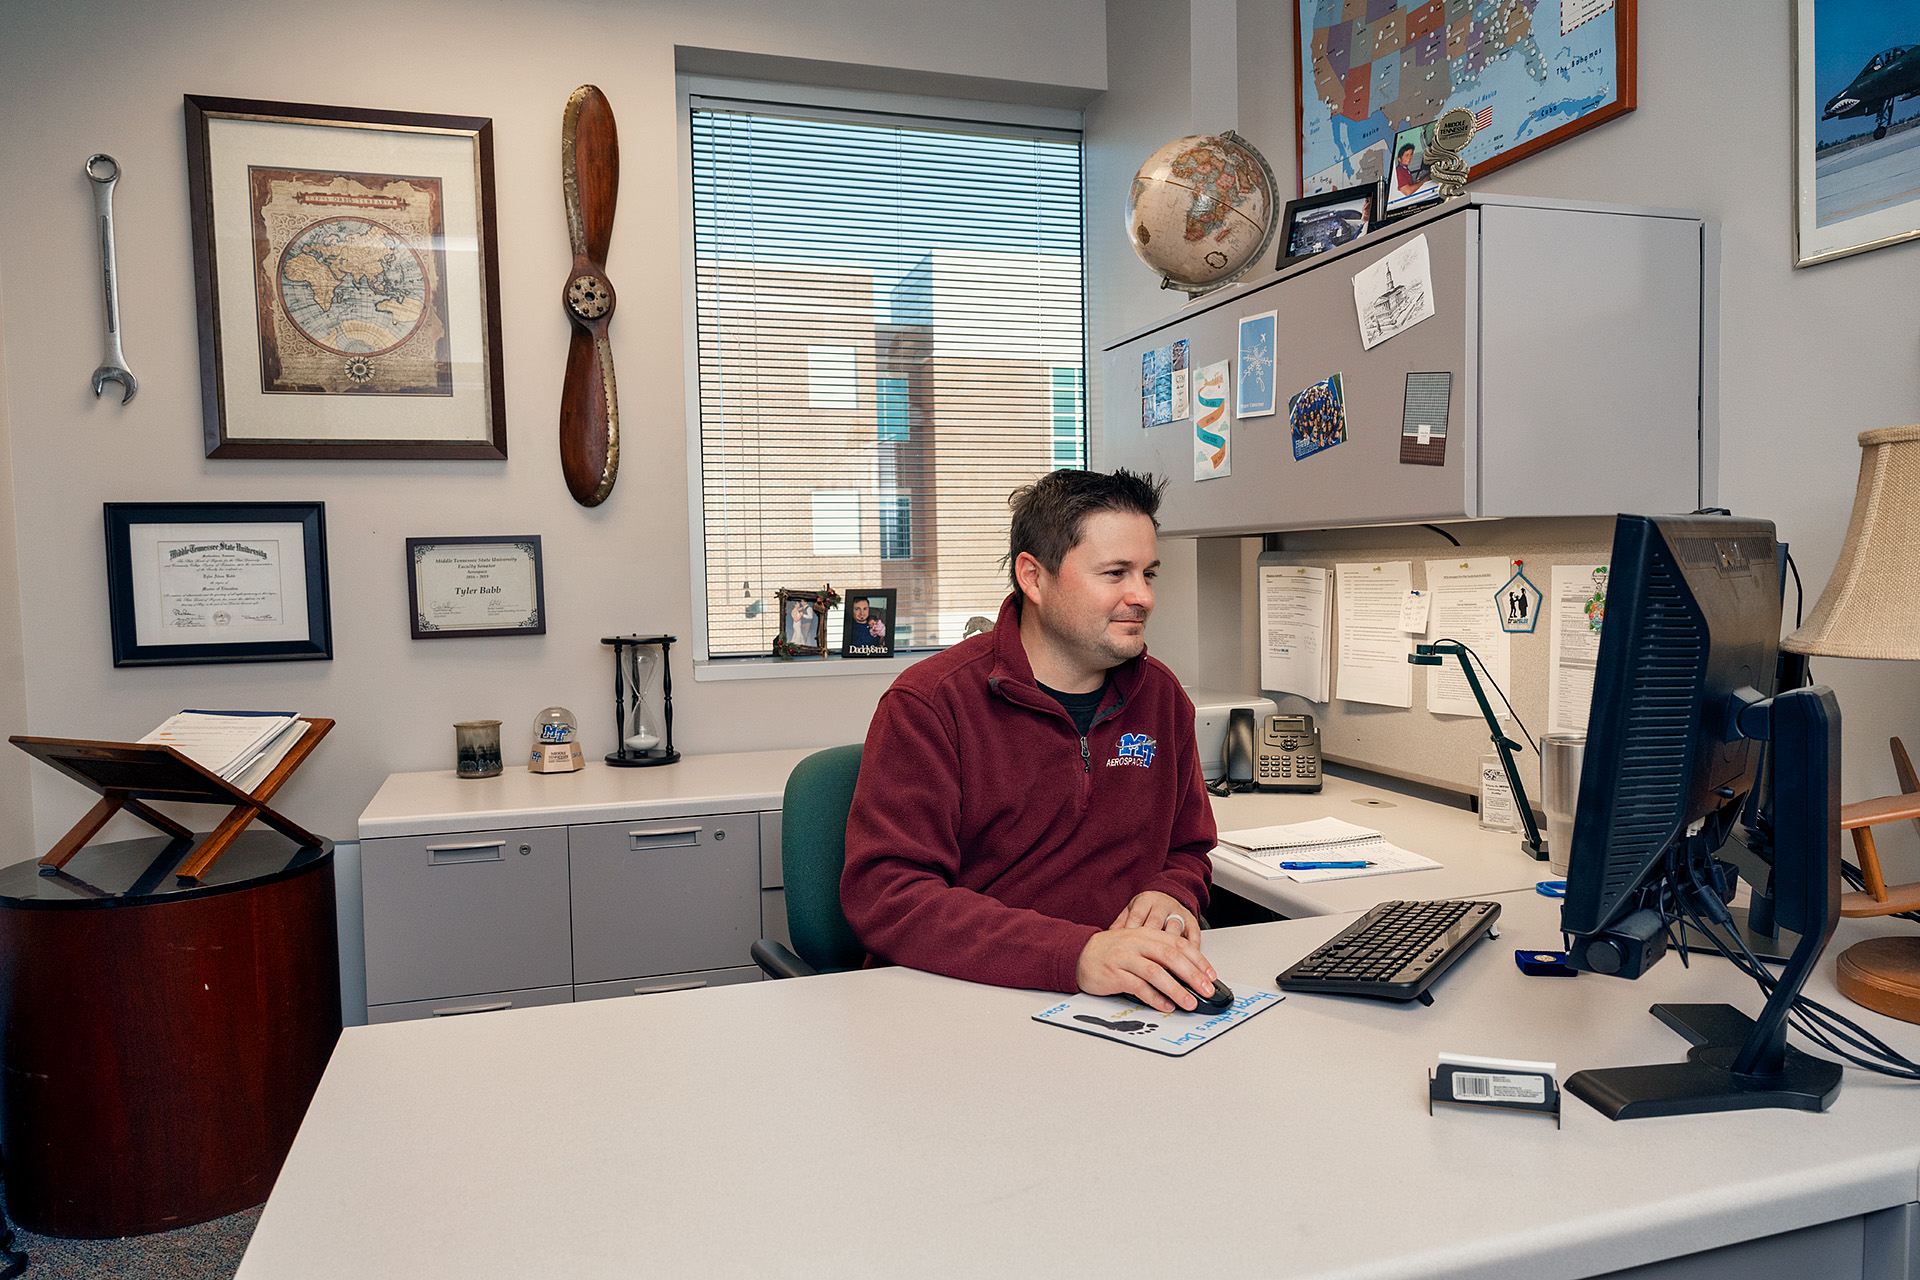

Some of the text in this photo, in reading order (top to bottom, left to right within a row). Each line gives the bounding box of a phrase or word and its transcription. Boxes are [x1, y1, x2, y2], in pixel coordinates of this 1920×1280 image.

[1571, 47, 1602, 68] Bahamas
[1475, 96, 1481, 106] of
[1481, 90, 1497, 102] Mexico
[1541, 105, 1557, 117] Cuba
[1440, 125, 1468, 135] TENNESSEE
[1444, 120, 1466, 129] MIDDLE
[1362, 127, 1379, 139] Mexico
[169, 541, 268, 560] Middle Tennessee State University
[455, 586, 502, 598] Tyler Babb
[543, 725, 568, 742] MT
[1118, 732, 1157, 769] MT
[1106, 757, 1144, 767] AEROSPACE
[1160, 991, 1279, 1046] Happy Father's Day
